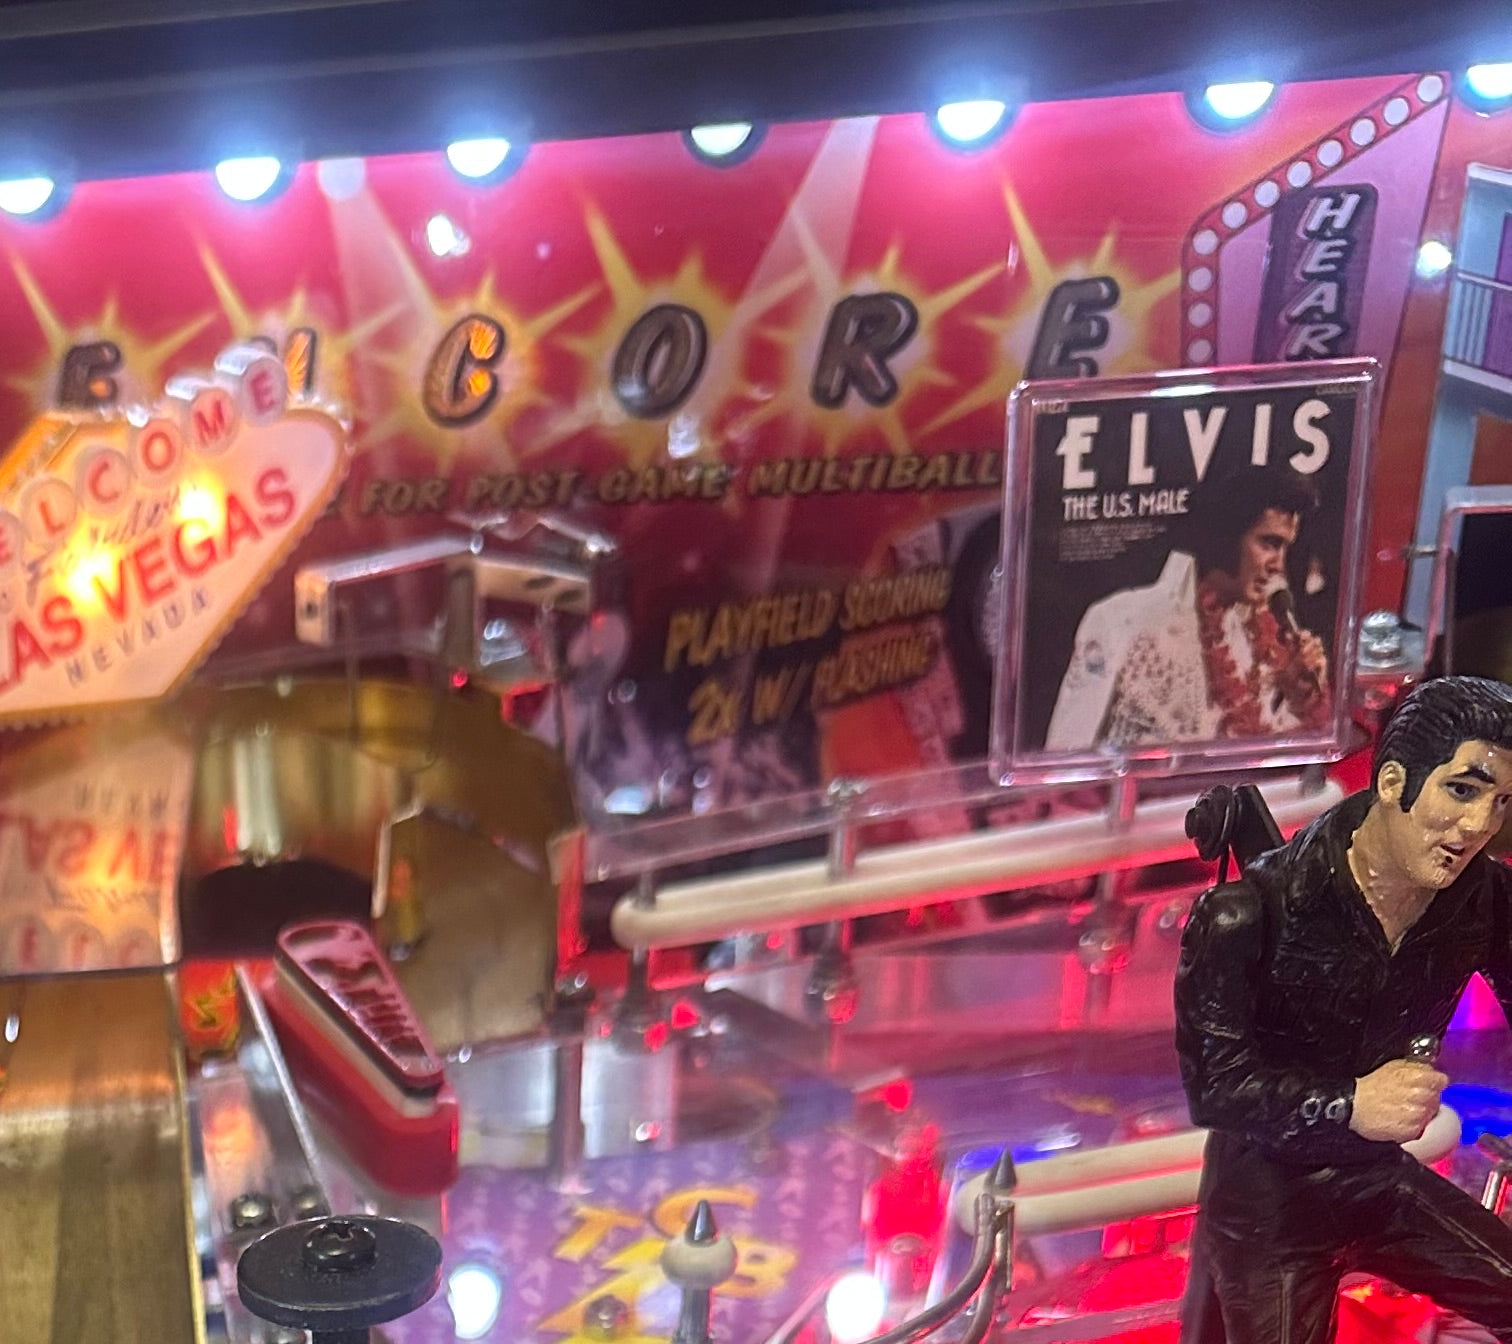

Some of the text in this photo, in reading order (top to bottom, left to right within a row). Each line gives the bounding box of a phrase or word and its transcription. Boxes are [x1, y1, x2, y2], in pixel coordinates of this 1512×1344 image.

[361, 478, 448, 514] FOR
[749, 451, 1002, 497] MULTIBALL
[1057, 399, 1331, 489] ELVIS
[94, 467, 296, 626] VEGAS
[1062, 488, 1190, 521] THE U.S. MALE
[663, 589, 836, 674] PLAYFIELD
